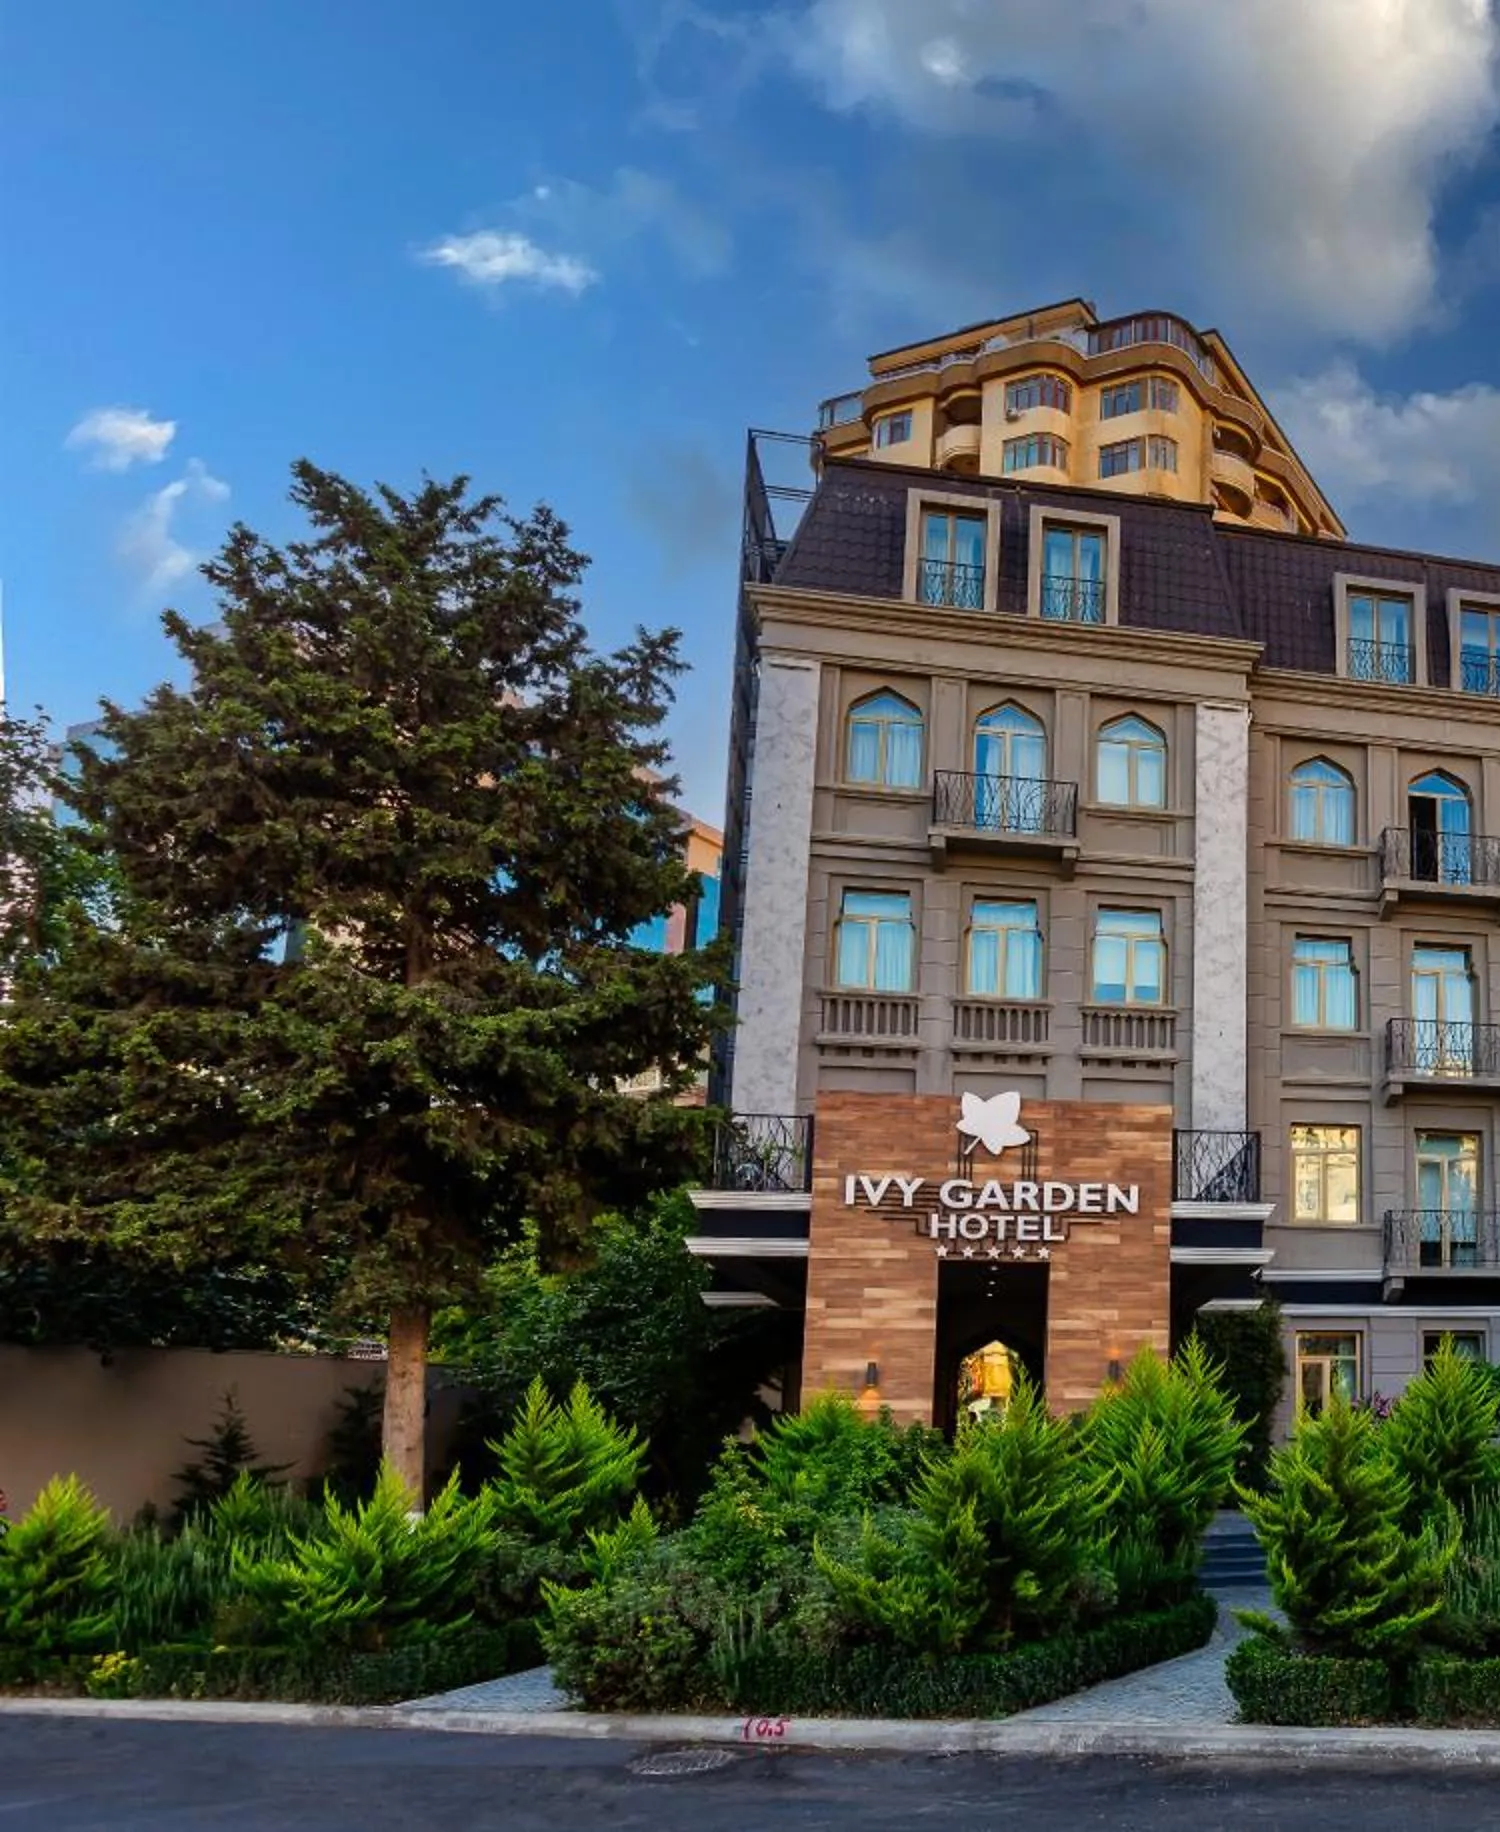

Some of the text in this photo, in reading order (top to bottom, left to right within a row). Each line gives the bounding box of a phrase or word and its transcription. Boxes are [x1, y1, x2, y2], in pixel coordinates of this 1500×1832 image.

[844, 1174, 1139, 1213] IVY GARDEN
[930, 1213, 1065, 1241] HOTEL
